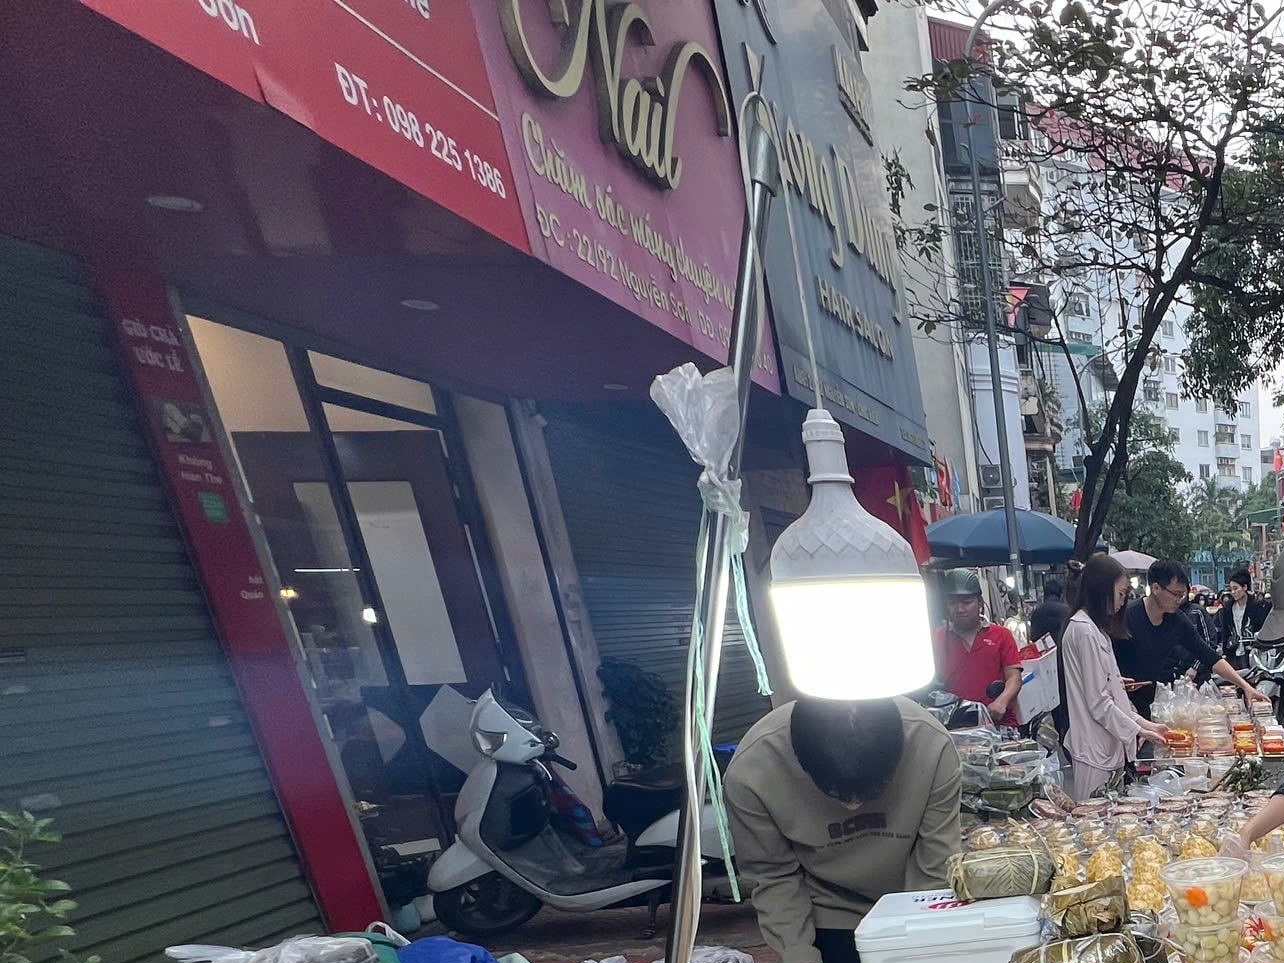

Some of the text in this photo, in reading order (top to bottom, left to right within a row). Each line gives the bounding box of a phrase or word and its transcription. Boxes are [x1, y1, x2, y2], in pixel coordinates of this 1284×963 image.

[382, 96, 424, 148] 098
[425, 122, 463, 172] 225
[464, 149, 506, 199] 1386
[521, 111, 592, 211] Chăm
[815, 275, 856, 333] HAIR
